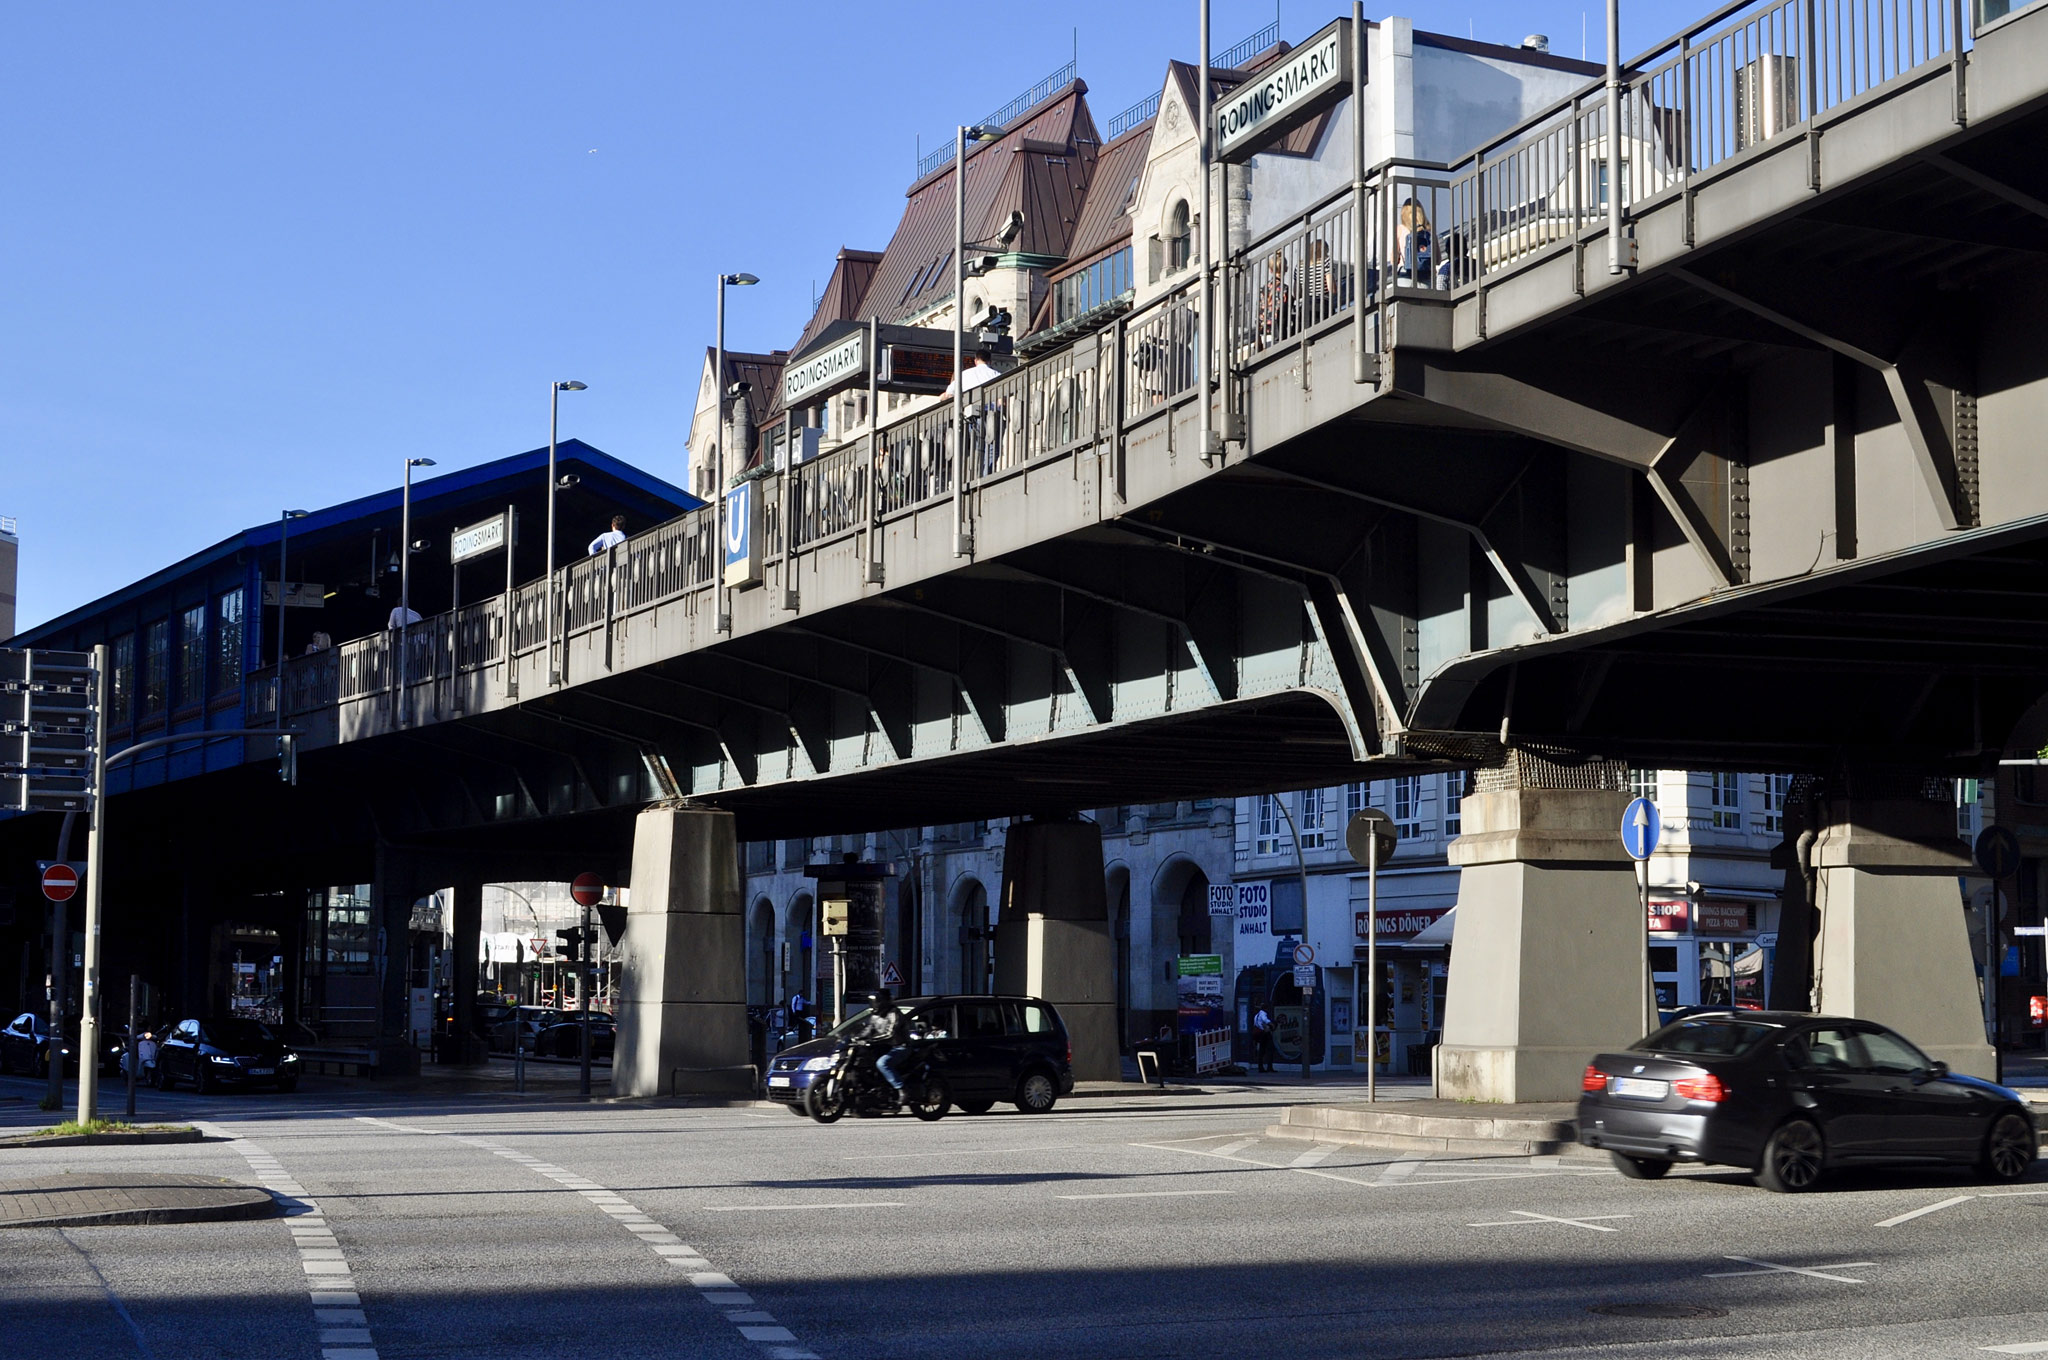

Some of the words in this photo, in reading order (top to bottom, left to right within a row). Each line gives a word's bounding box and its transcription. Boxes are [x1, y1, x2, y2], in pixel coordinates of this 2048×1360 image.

[787, 341, 861, 396] RODINGSMARKT
[1210, 886, 1234, 901] FOTO
[1239, 885, 1267, 904] FOTO
[1239, 905, 1268, 919] STUDIO
[1648, 905, 1681, 916] SHOP
[1239, 922, 1267, 935] ANHALT
[1357, 914, 1398, 934] RÖINGS
[1399, 912, 1432, 933] DÖNER
[1724, 918, 1740, 929] PASTA
